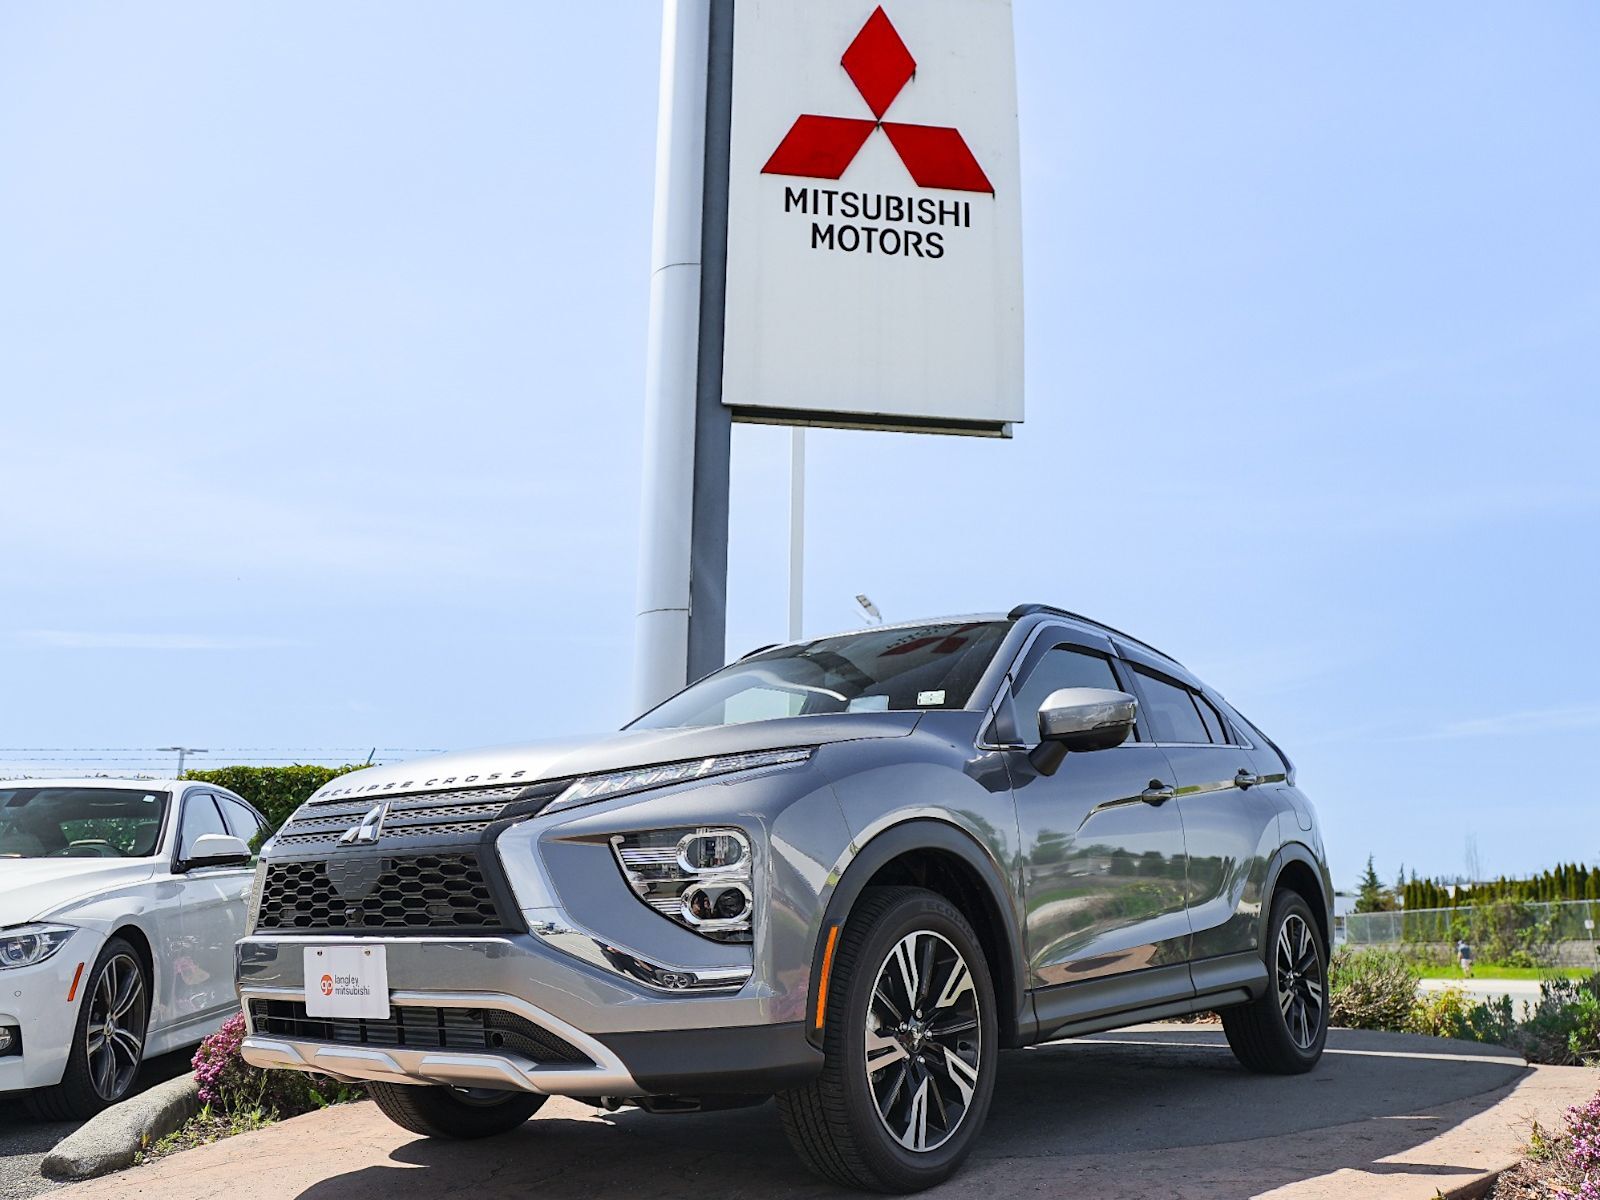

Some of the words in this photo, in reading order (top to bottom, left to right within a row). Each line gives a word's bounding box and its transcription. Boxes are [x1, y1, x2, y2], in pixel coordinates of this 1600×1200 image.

[785, 187, 970, 228] MITSUBISHI
[811, 222, 944, 259] MOTORS
[319, 781, 414, 798] ECLIPSE
[425, 770, 526, 786] CROSS
[334, 974, 359, 987] langley
[335, 985, 371, 996] mitsubishi
